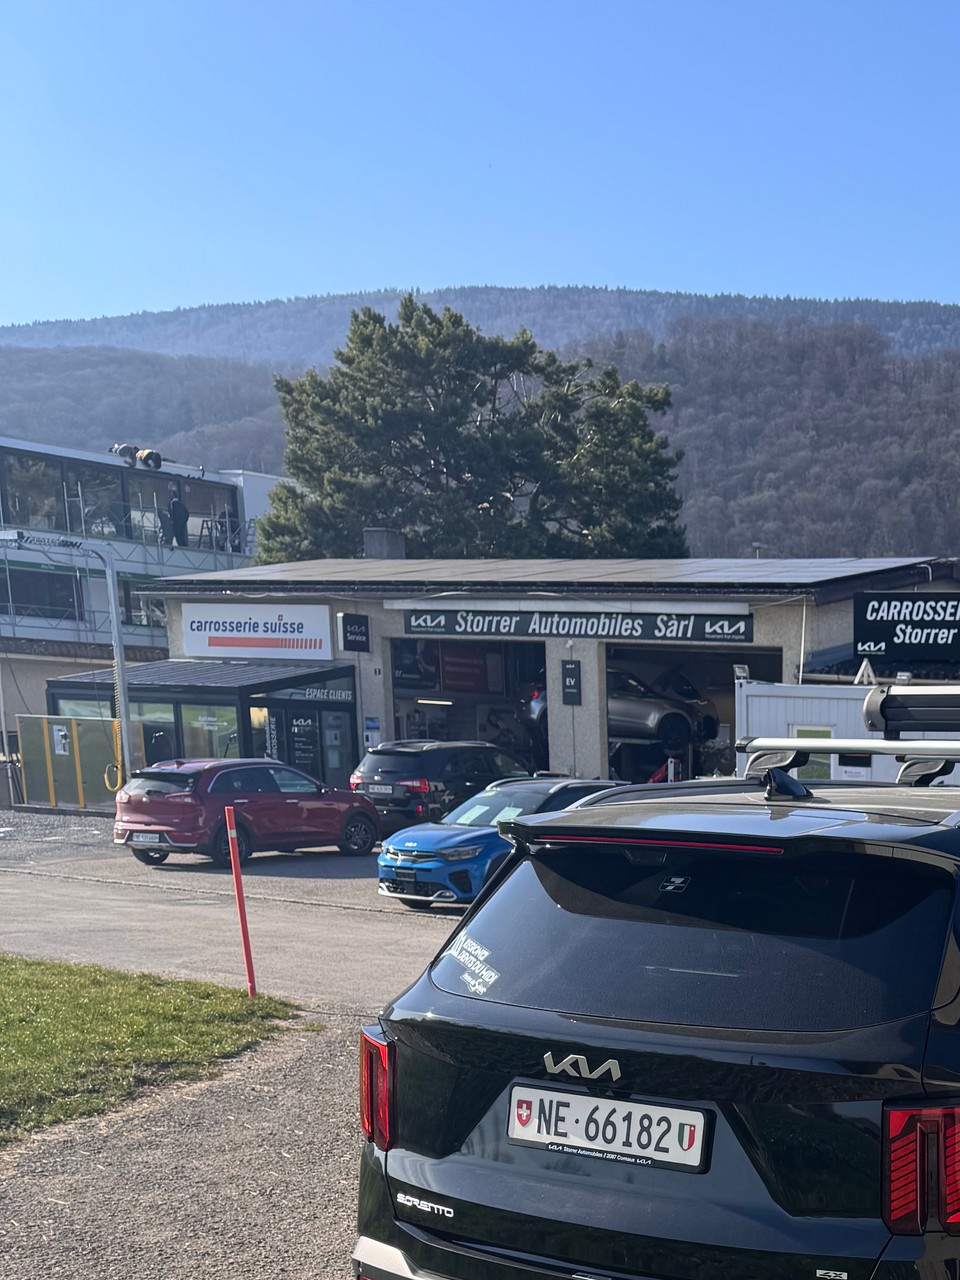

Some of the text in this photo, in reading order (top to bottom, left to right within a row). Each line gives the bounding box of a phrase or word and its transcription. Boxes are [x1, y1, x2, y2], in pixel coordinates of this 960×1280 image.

[190, 615, 304, 634] carrosserie suisse
[411, 611, 746, 638] KIA Storrer Automobiles Sàrl KIA
[893, 623, 958, 645] Storrer
[857, 641, 886, 652] KIA
[566, 678, 576, 686] EV
[305, 688, 353, 700] ESPACE CLIENTS
[292, 718, 312, 726] KIA
[543, 1051, 622, 1082] KIA
[396, 1192, 454, 1218] SORENTO
